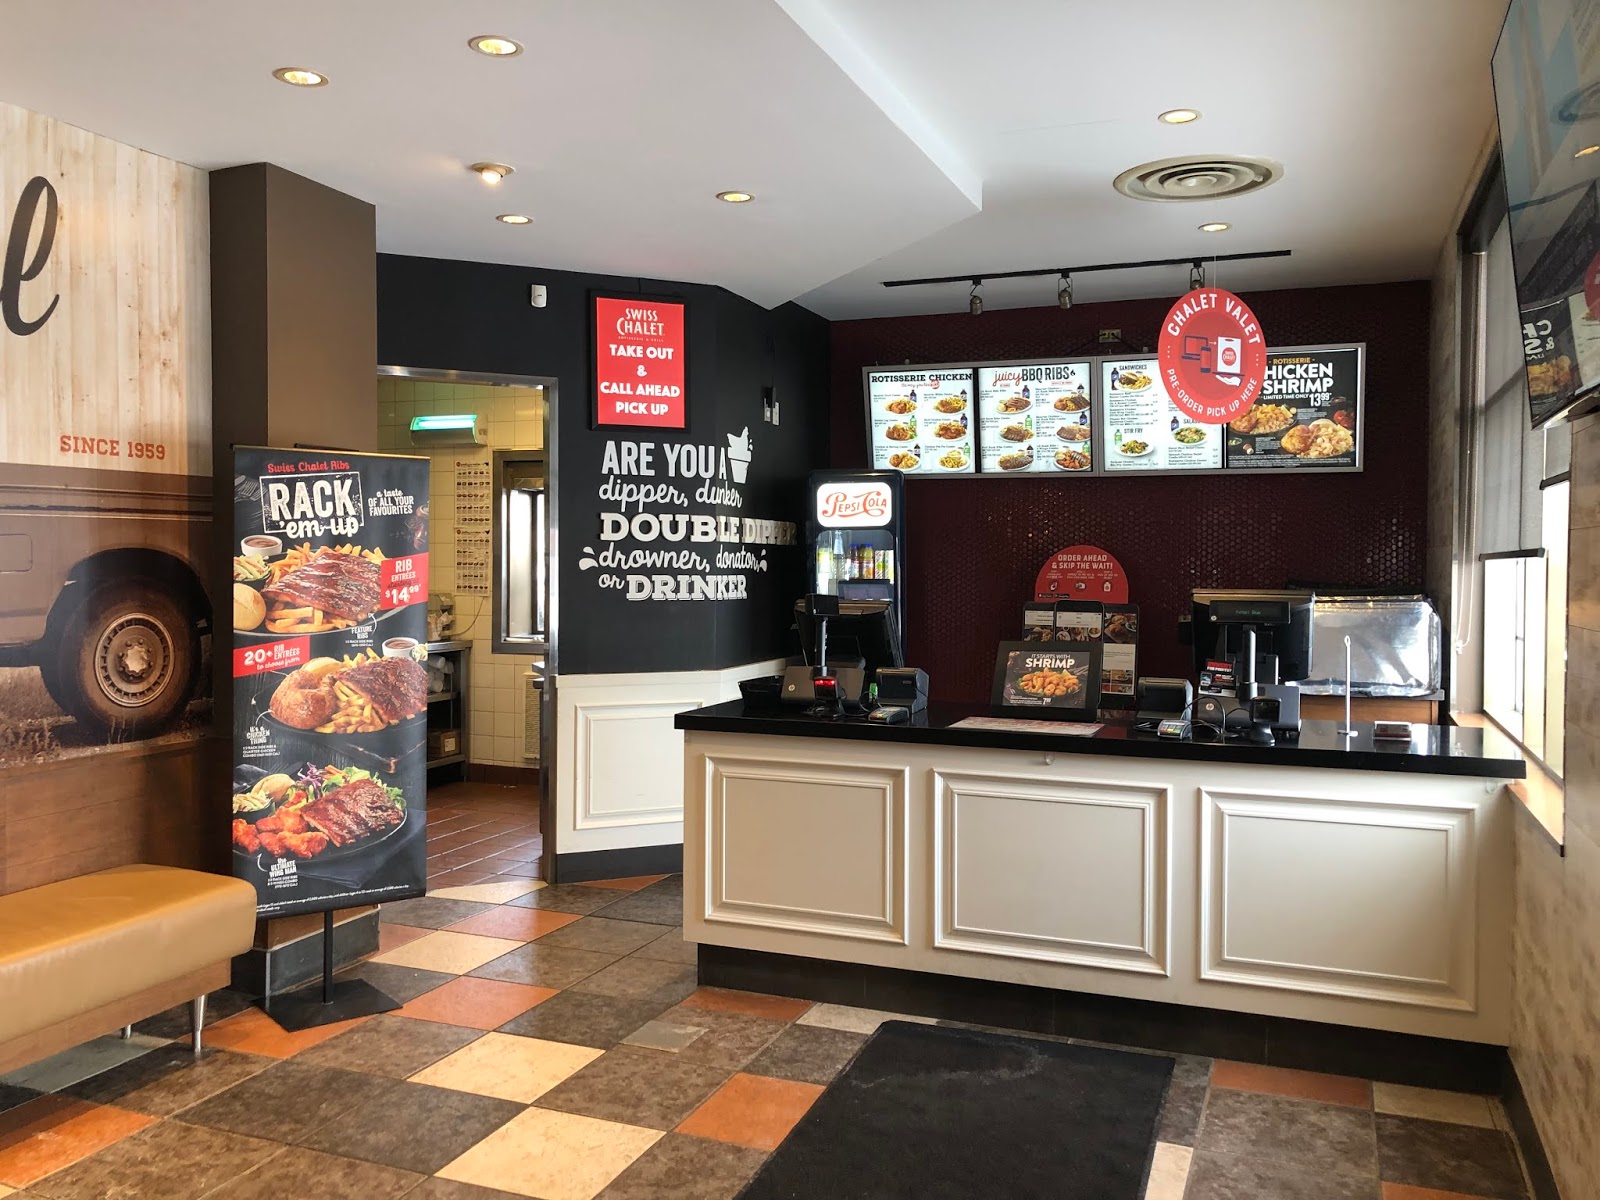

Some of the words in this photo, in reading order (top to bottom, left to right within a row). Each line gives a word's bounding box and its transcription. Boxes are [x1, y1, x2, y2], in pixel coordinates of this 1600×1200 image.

[625, 308, 658, 321] SWISS
[1167, 293, 1218, 337] CHALET
[1225, 298, 1261, 344] VALET
[616, 317, 664, 336] CHALET
[609, 344, 643, 358] TAKE
[646, 346, 674, 360] OUT
[1273, 357, 1311, 365] ROTISSERIE
[636, 365, 647, 377] &
[871, 374, 926, 383] ROTISSERIE
[928, 373, 972, 381] CHICKEN
[992, 371, 1023, 387] juicy
[1021, 367, 1043, 383] BBQ
[1045, 366, 1070, 380] RIBS
[1263, 362, 1333, 380] HICKEN
[600, 381, 633, 395] CALL
[636, 384, 681, 398] AHEAD
[1167, 368, 1204, 414] PRE-ORDER
[1206, 407, 1226, 417] PICK
[1229, 401, 1240, 413] UP
[1240, 378, 1257, 402] HERE
[1262, 377, 1334, 395] SHRIMP
[616, 401, 648, 415] PICK
[651, 403, 669, 416] UP
[60, 435, 120, 457] SINCE
[127, 441, 166, 460] 1959
[267, 463, 296, 473] Swiss
[298, 461, 329, 471] Chalet
[330, 460, 350, 470] Ribs
[601, 440, 656, 476] ARE
[663, 443, 715, 478] YOU
[718, 447, 727, 480] A
[268, 479, 357, 521] RACK
[367, 497, 378, 507] OF
[380, 496, 393, 507] ALL
[394, 495, 415, 506] YOUR
[383, 488, 404, 498] taste
[598, 475, 689, 513] dipper,
[695, 479, 743, 508] dunker
[369, 504, 413, 517] FAVOURITES
[330, 517, 359, 538] up
[600, 512, 740, 543] DOUBLE
[395, 558, 413, 573] RIB
[598, 542, 711, 573] drowner,
[1057, 554, 1081, 562] ORDER
[1082, 554, 1107, 562] AHEAD
[1092, 562, 1113, 570] WAIT!
[598, 573, 625, 590] or
[626, 574, 747, 601] DRINKER
[351, 625, 373, 635] FEATURE
[273, 643, 285, 653] RIB
[244, 648, 273, 666] 20+
[1025, 658, 1075, 669] SHRIMP
